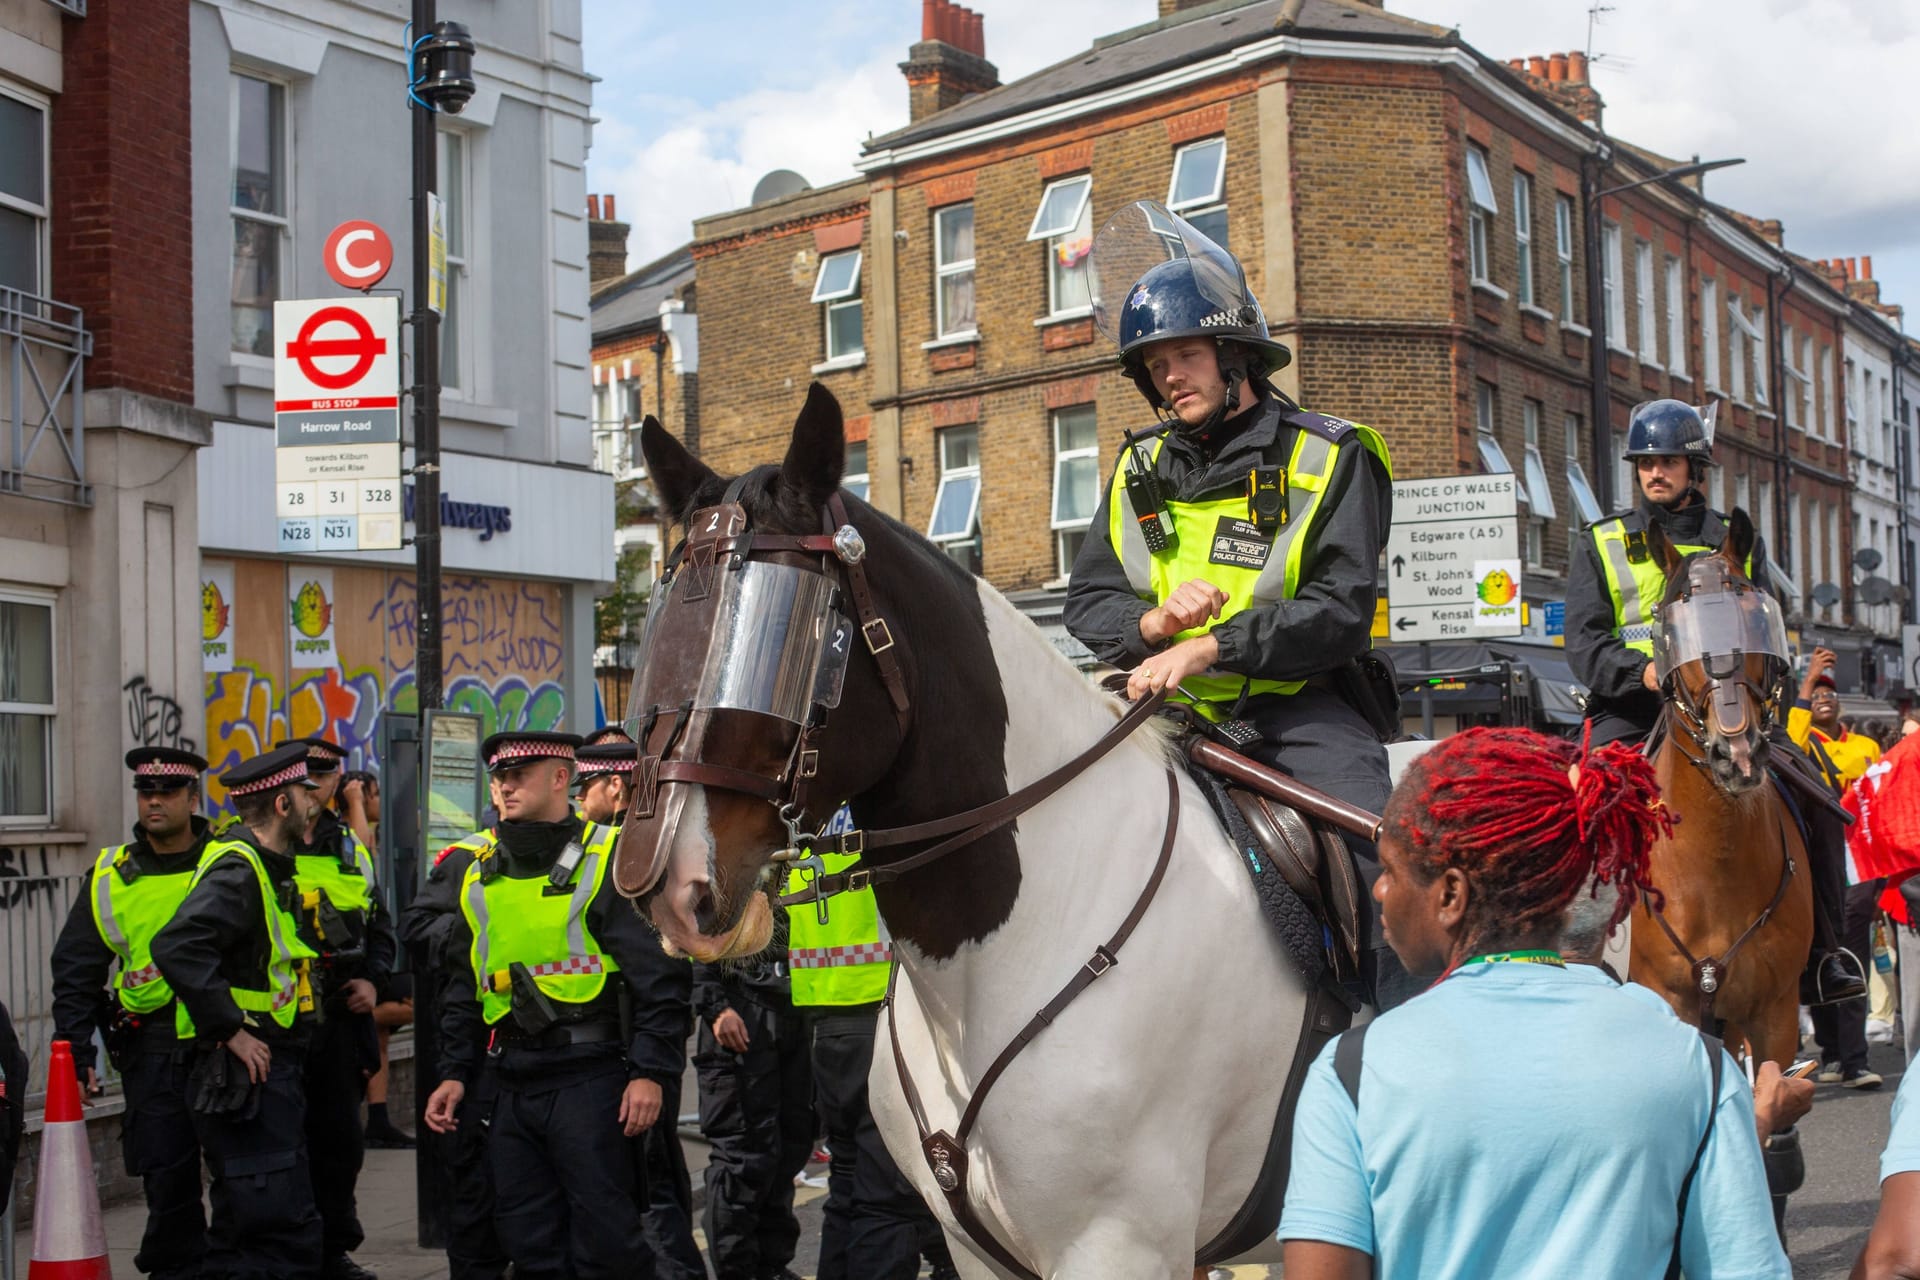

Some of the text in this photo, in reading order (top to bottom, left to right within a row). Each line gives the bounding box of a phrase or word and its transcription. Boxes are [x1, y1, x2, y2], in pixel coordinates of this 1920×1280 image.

[312, 399, 361, 409] BUS STOP
[301, 421, 372, 433] Harrow Road
[305, 453, 369, 462] towards Kilburn
[319, 465, 346, 473] Kensal
[1443, 485, 1461, 496] OF
[1466, 482, 1512, 495] WALES
[288, 493, 304, 505] 28
[330, 491, 345, 503] 31
[366, 490, 392, 502] 328
[1417, 501, 1485, 514] JUNCTION
[706, 512, 719, 533] 2
[283, 527, 311, 540] N28
[324, 526, 351, 538] N31
[1411, 529, 1465, 544] Edgware
[1236, 546, 1259, 556] POLICE
[1411, 551, 1457, 562] Kilburn
[1213, 552, 1264, 566] POLICE OFFICER
[1413, 568, 1473, 582] St. John's
[1427, 586, 1463, 597] Wood
[1432, 609, 1474, 621] Kensal
[1440, 624, 1467, 635] Rise
[832, 628, 845, 653] 2
